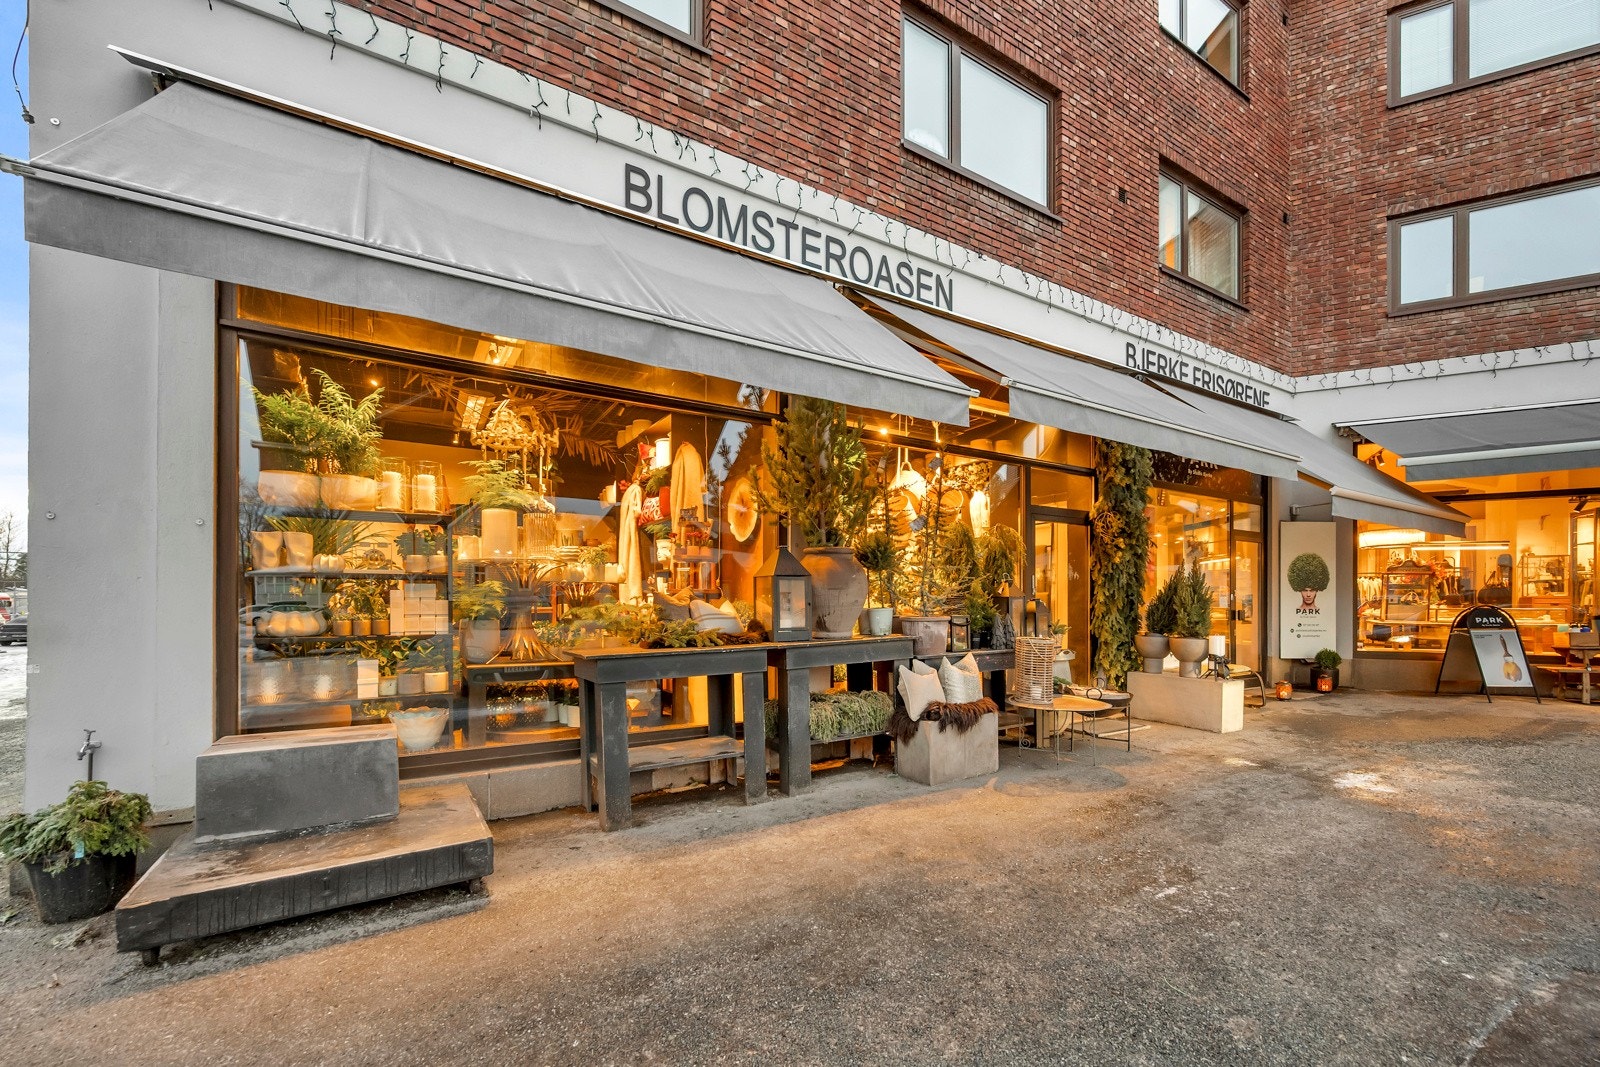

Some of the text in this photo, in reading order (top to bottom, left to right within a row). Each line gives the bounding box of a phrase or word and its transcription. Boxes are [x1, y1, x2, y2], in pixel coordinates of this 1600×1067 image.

[625, 163, 953, 311] BLOMSTEROASEN
[1125, 342, 1270, 408] BJERKE FRISØRENE
